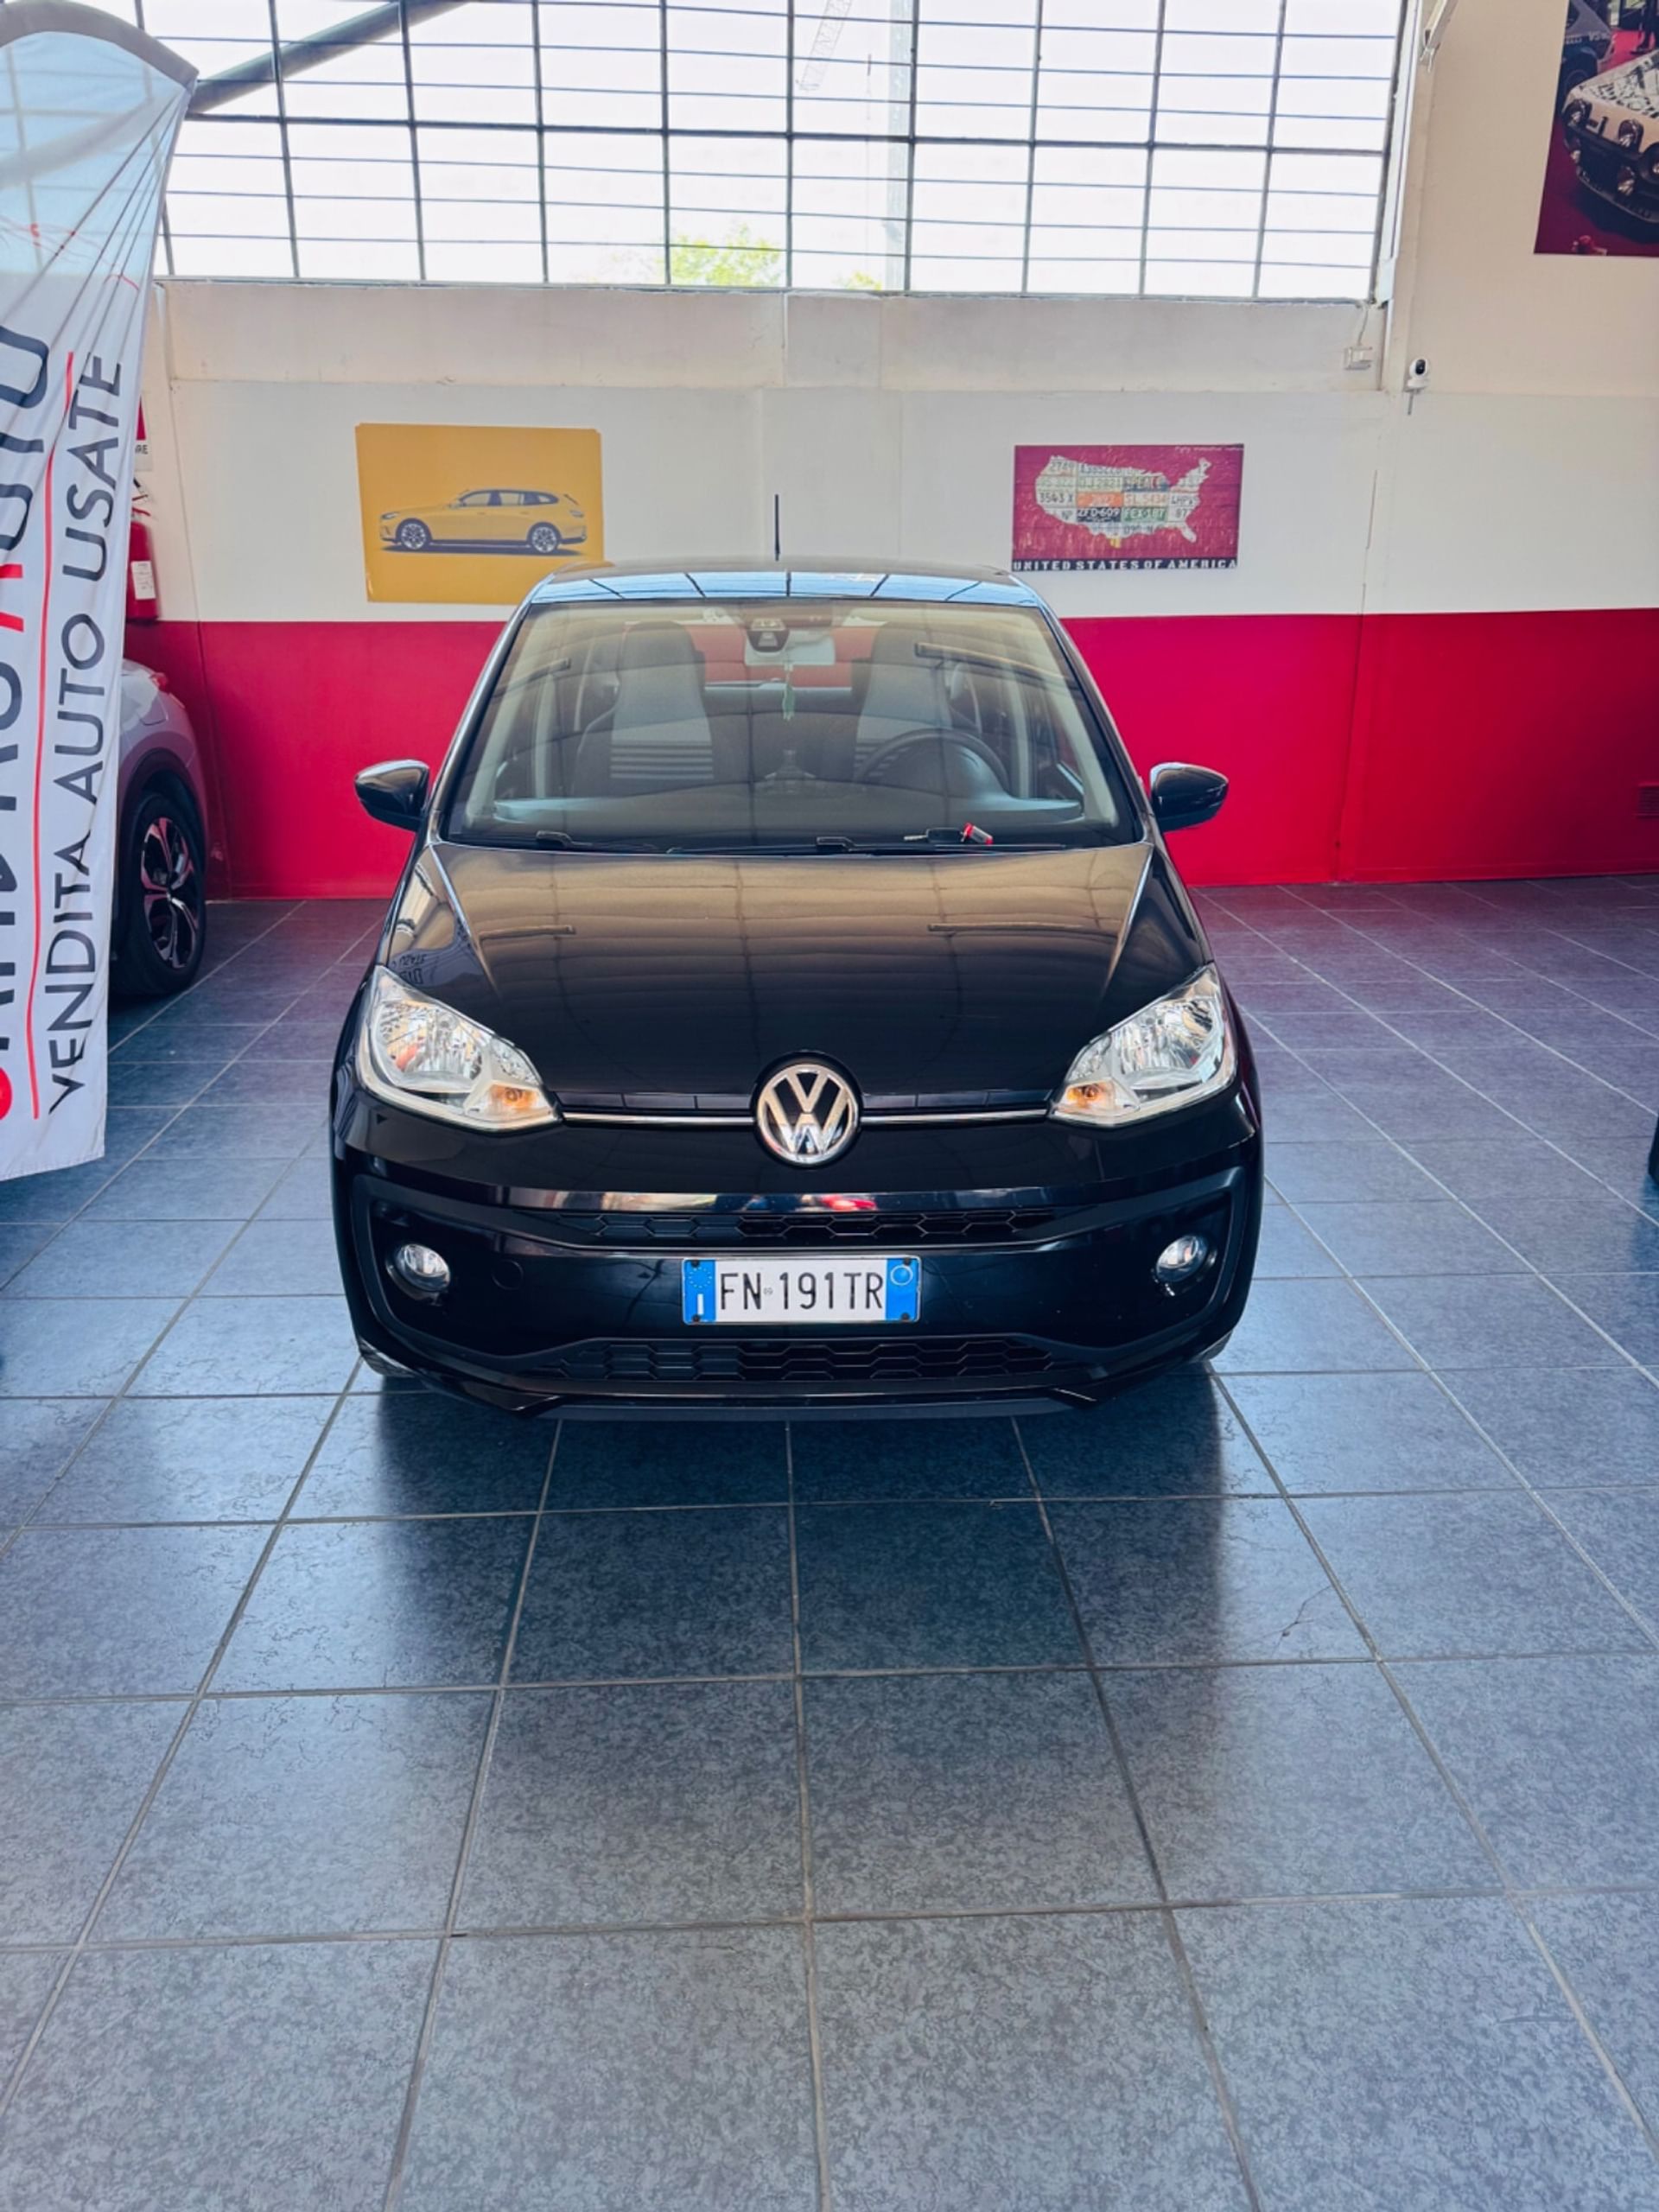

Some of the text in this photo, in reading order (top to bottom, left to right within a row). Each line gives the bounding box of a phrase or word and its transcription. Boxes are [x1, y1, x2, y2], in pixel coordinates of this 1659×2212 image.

[1013, 559, 1237, 570] UNITED STATES OF AMERICA
[45, 354, 121, 1115] VENDITA AUTO USATE
[757, 1064, 858, 1164] VW
[720, 1271, 884, 1310] FN 191TR
